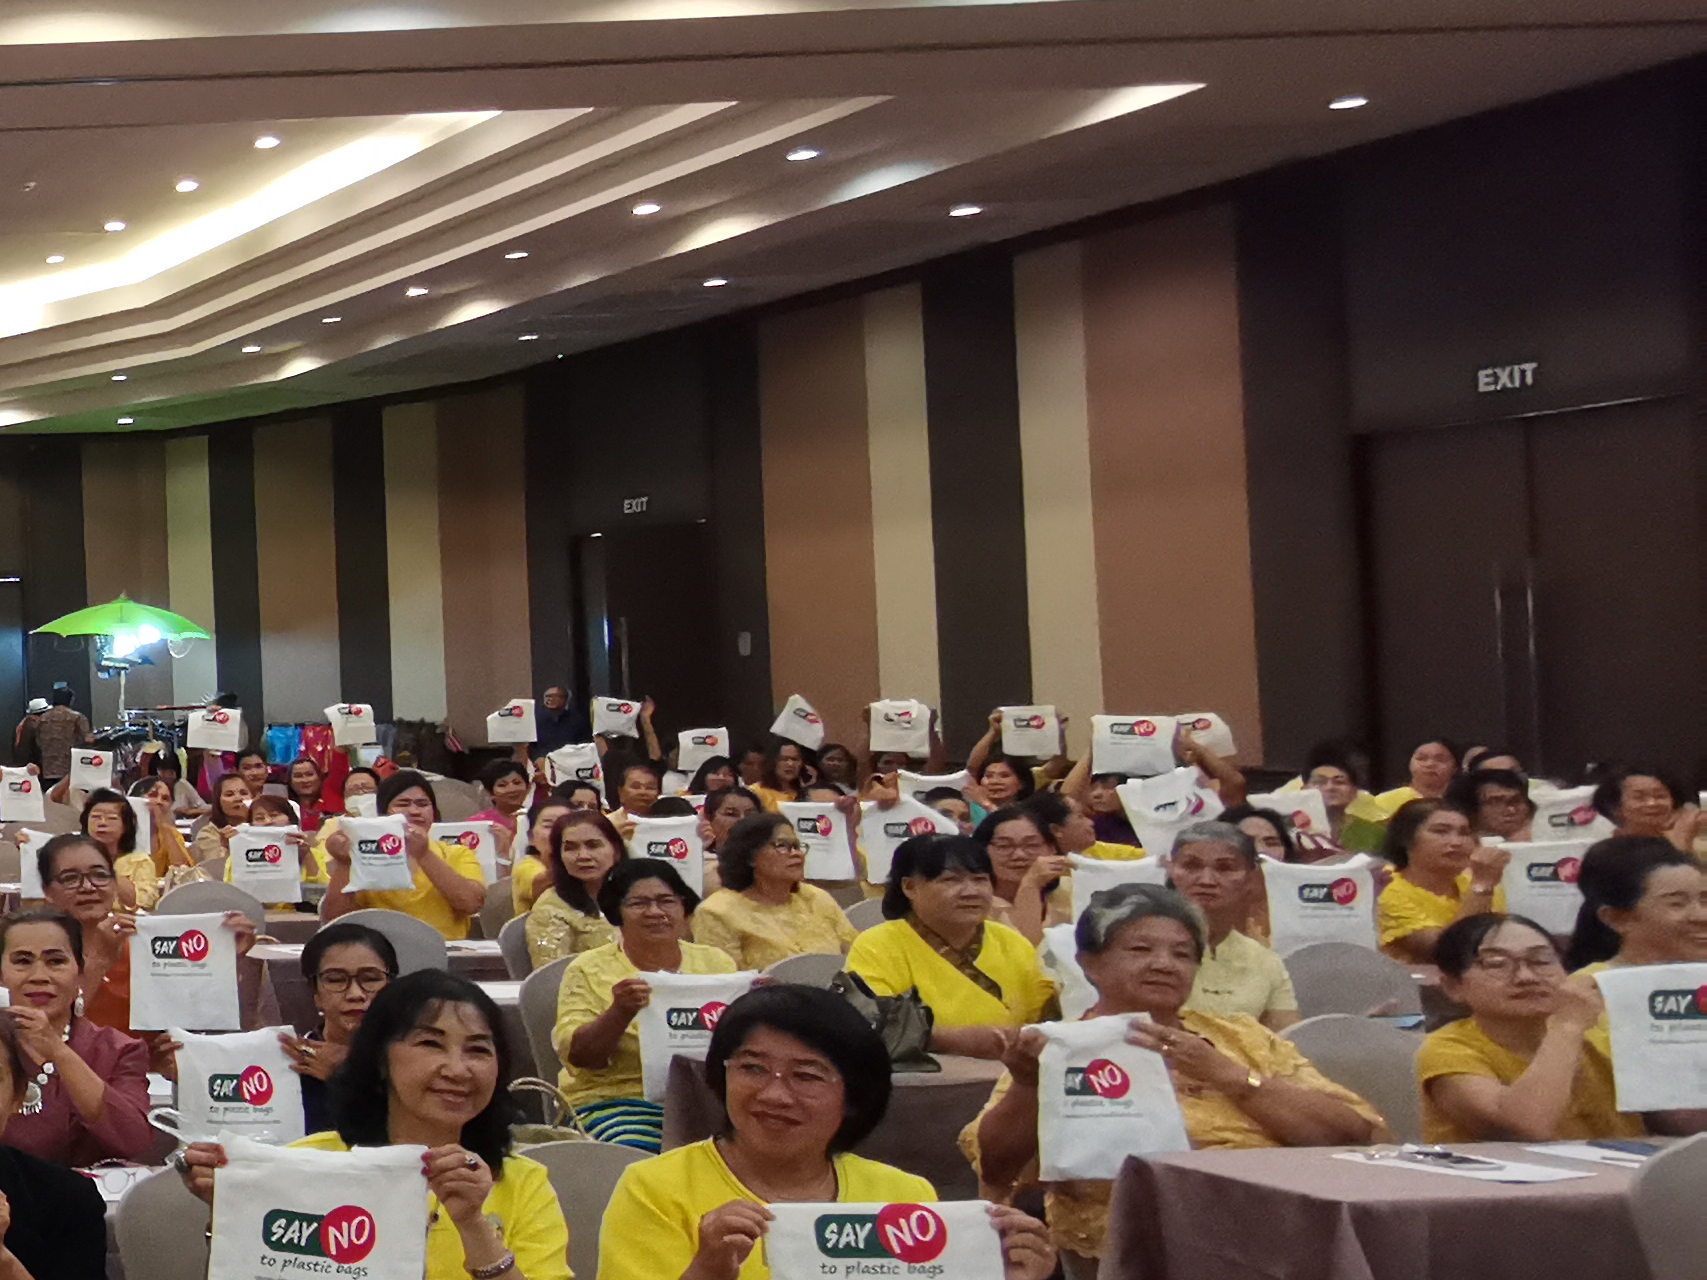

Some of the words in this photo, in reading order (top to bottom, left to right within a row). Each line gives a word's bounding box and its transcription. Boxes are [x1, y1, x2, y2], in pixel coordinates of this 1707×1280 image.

[1477, 362, 1538, 392] EXIT
[623, 496, 649, 513] EXIT
[154, 941, 176, 954] SAY
[181, 934, 205, 958] NO
[1653, 994, 1692, 1014] SAY
[670, 1012, 697, 1026] SAY
[213, 1078, 237, 1096] SAY
[242, 1071, 268, 1100] NO
[1089, 1064, 1122, 1094] NO
[270, 1218, 318, 1247] SAY
[328, 1216, 370, 1255] NO
[824, 1222, 873, 1249] SAY
[884, 1210, 937, 1254] NO
[260, 1254, 277, 1267] to
[280, 1257, 332, 1275] plastic
[336, 1262, 369, 1280] bags
[819, 1261, 837, 1275] to
[845, 1261, 900, 1279] plastic
[907, 1263, 945, 1279] bags
